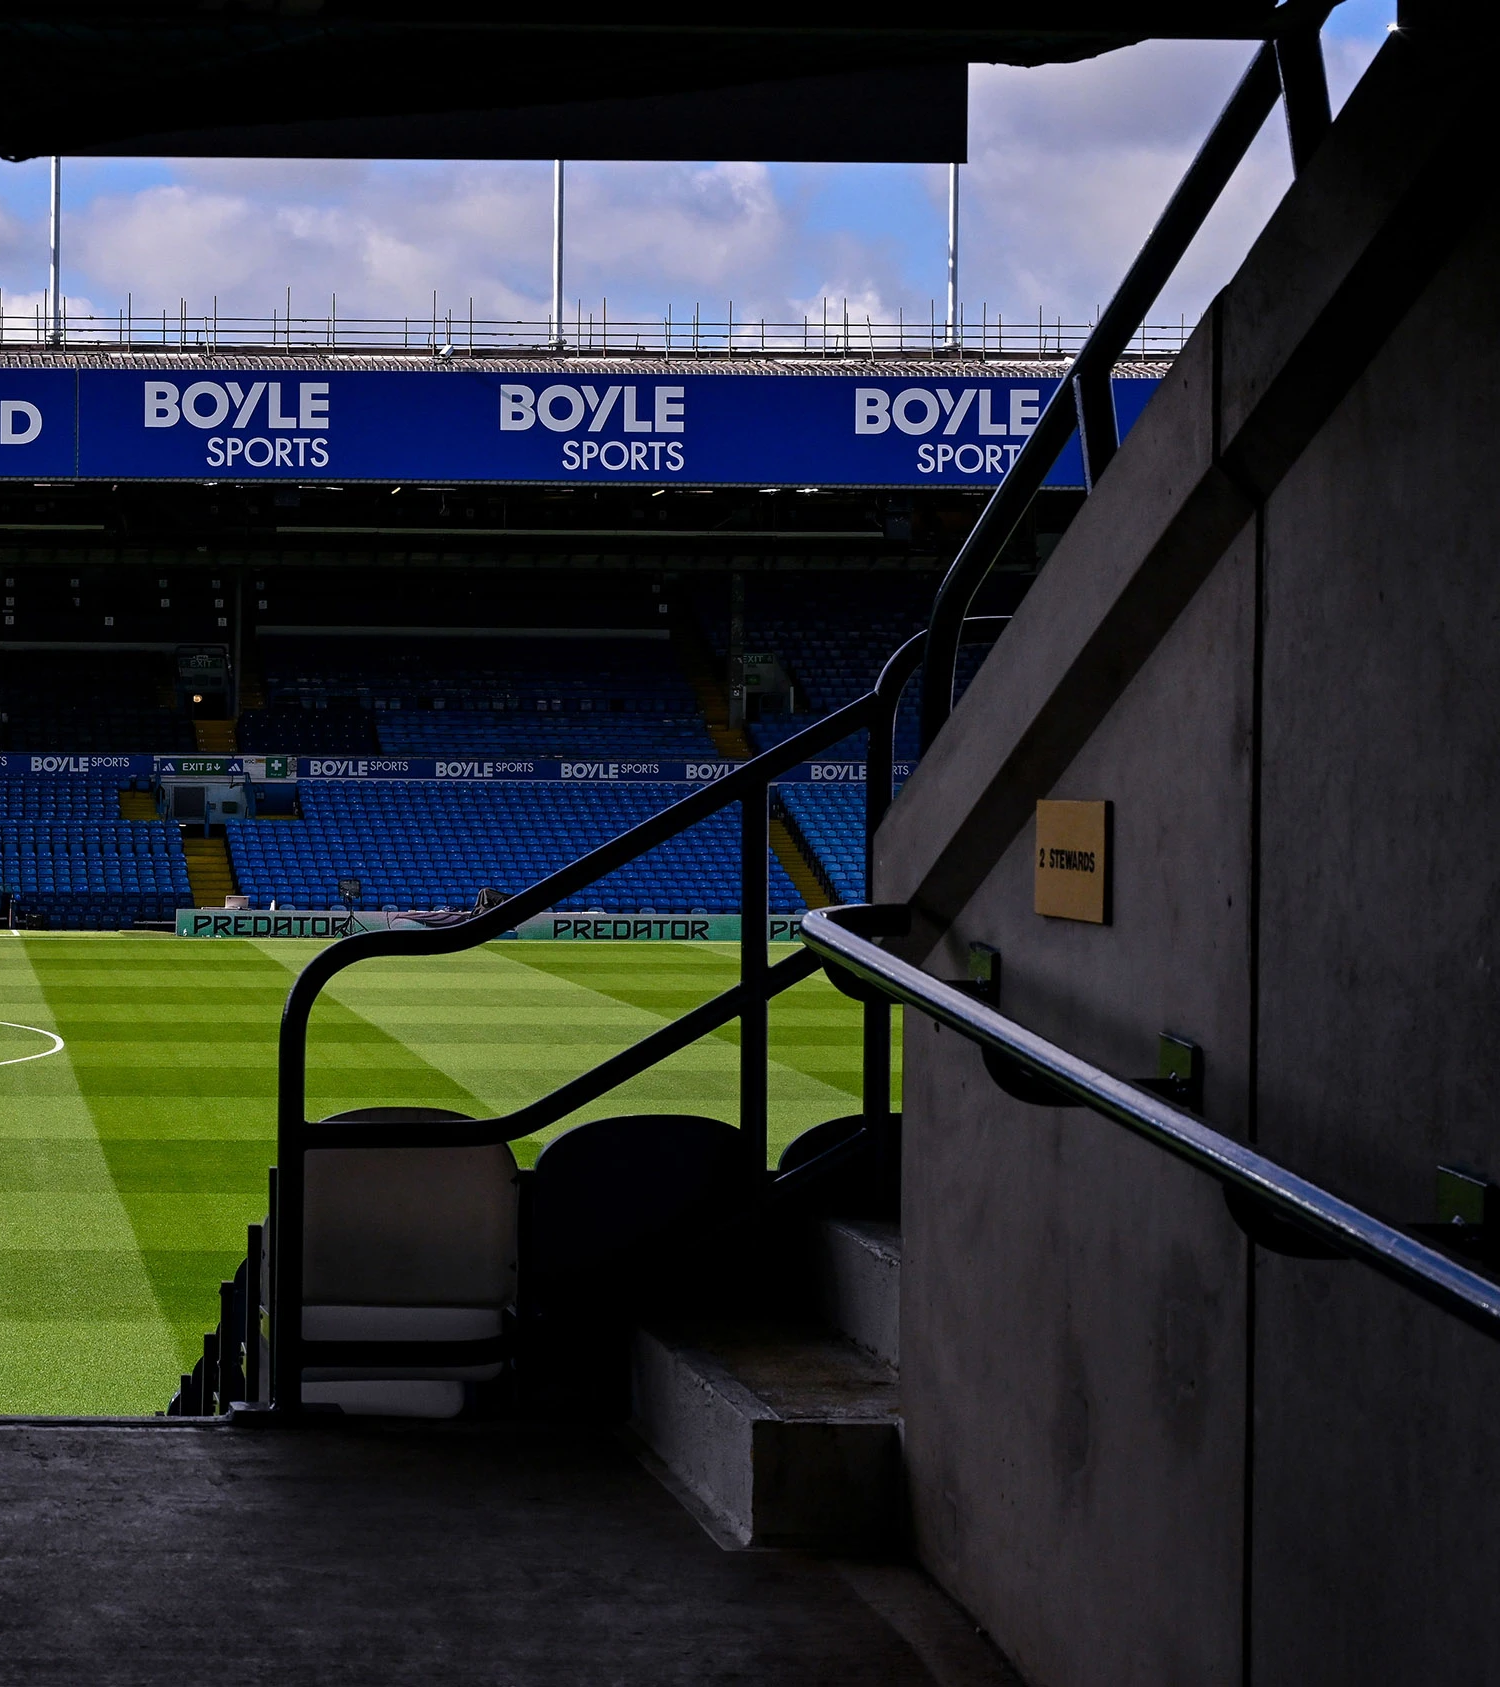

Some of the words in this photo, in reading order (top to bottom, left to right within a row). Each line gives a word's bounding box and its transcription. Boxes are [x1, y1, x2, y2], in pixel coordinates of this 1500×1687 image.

[145, 381, 329, 430] BOYLE
[500, 384, 684, 433] BOYLE
[855, 388, 1039, 435] BOYLE
[206, 437, 329, 467] SPORTS
[562, 440, 685, 471] SPORTS
[917, 443, 1020, 474] SPORT
[190, 660, 212, 668] EXIT
[31, 757, 89, 773] BOYLE
[91, 757, 130, 768] SPORTS
[182, 762, 204, 771] EXIT
[310, 760, 368, 776] BOYLE
[370, 761, 409, 772] SPORTS
[436, 762, 494, 778] BOYLE
[496, 762, 534, 773] SPORTS
[561, 763, 619, 779] BOYLE
[621, 764, 660, 774] SPORTS
[686, 764, 745, 780] BOYL
[811, 765, 867, 780] BOYLE
[1039, 848, 1045, 868] 2
[1049, 849, 1095, 873] STEWARDS
[194, 915, 349, 936] PREDATOR
[553, 920, 710, 940] PREDATOR
